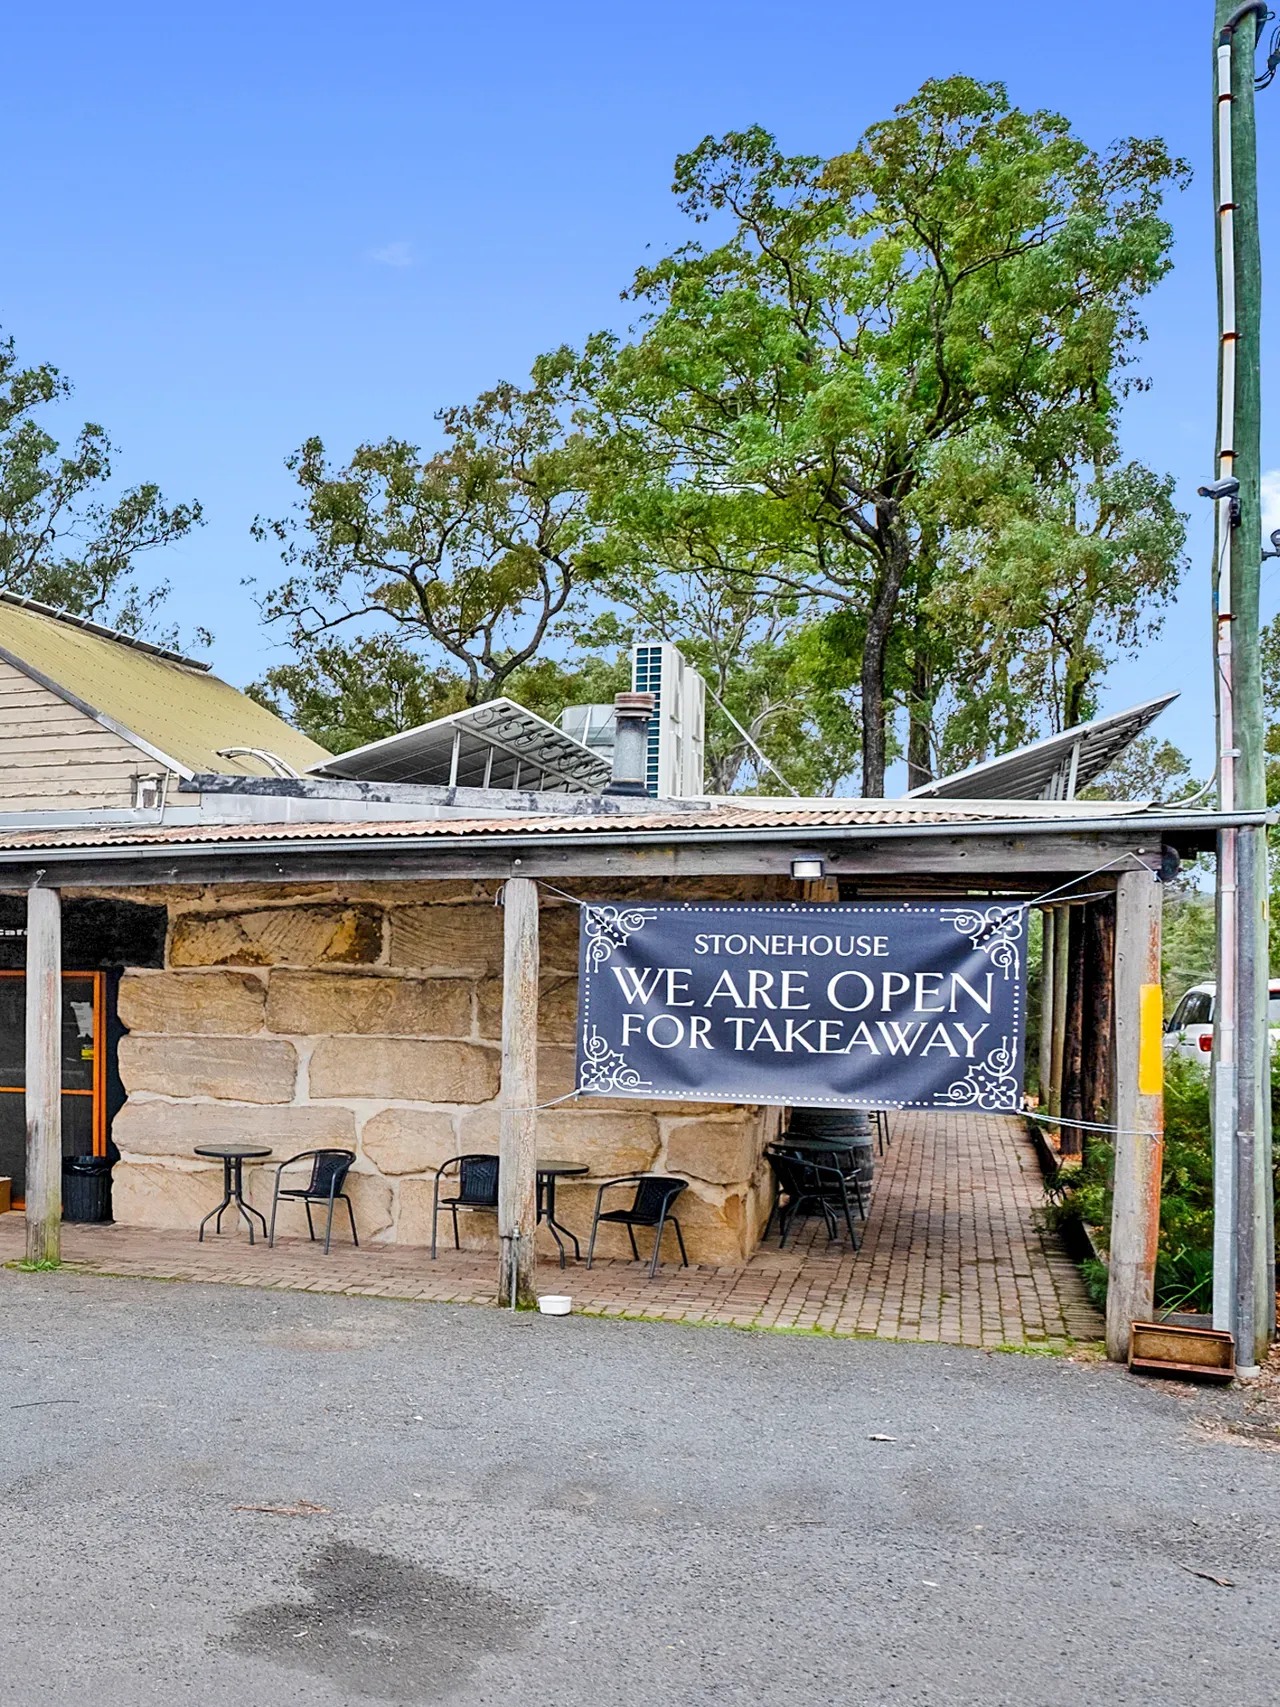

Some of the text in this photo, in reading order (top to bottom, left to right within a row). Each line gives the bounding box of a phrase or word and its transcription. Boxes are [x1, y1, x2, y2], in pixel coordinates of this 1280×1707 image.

[694, 933, 890, 957] STONEHOUSE
[610, 966, 995, 1014] WE ARE OPEN
[621, 1013, 991, 1058] FOR TAKEAWAY
